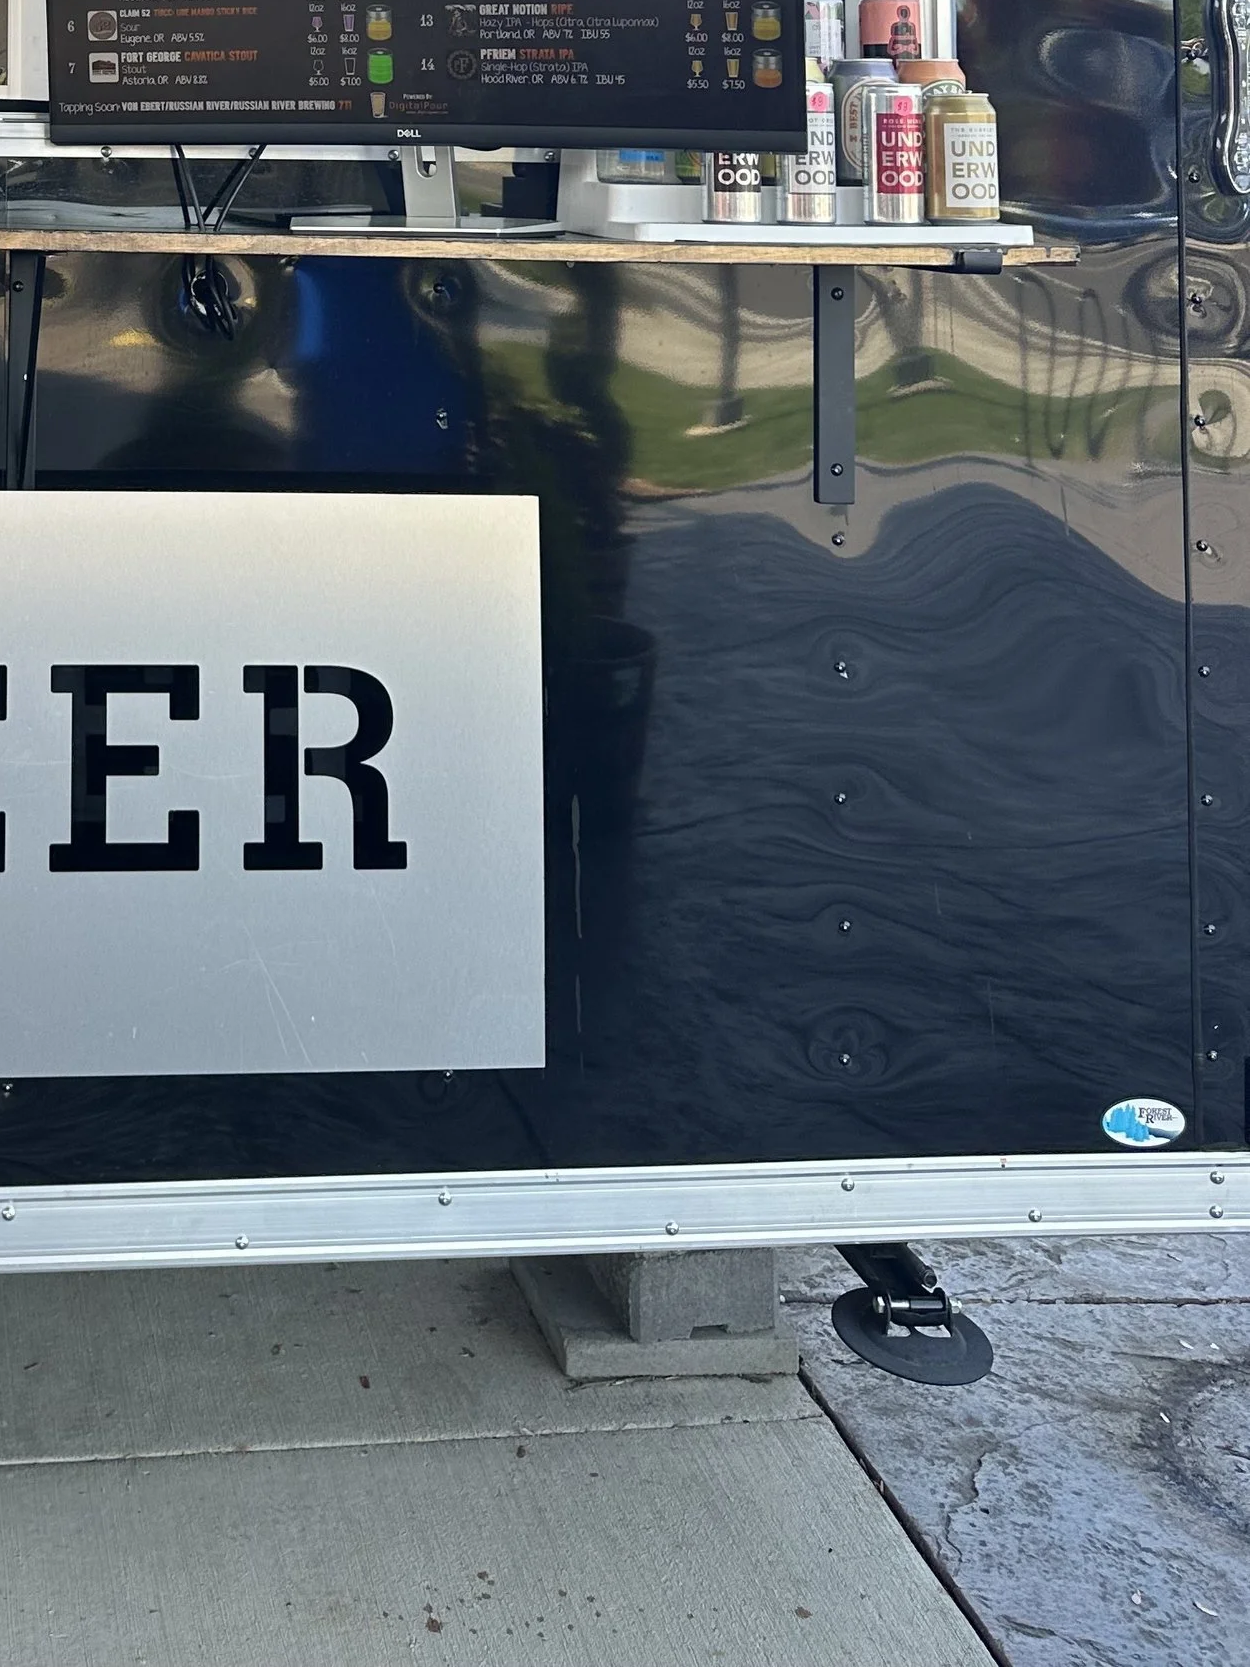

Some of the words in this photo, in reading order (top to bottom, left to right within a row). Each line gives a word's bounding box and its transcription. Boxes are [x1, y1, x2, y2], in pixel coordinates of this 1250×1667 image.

[479, 4, 509, 15] GREAT
[513, 4, 547, 15] NOTION
[69, 63, 75, 74] 7
[121, 52, 143, 63] FORT
[147, 51, 181, 62] GEORGE
[184, 51, 225, 62] CAVATICA
[229, 49, 258, 61] STOUT
[397, 129, 421, 137] DELL
[881, 131, 922, 147] UND
[951, 141, 995, 157] UND
[718, 153, 759, 165] ERW
[882, 151, 922, 167] ERW
[718, 168, 760, 186] OOD
[795, 170, 835, 185] OOD
[952, 162, 995, 178] ERW
[882, 170, 923, 187] OOD
[952, 183, 996, 200] OOD
[1138, 1107, 1172, 1118] FOREST
[1146, 1114, 1172, 1123] RIVER
